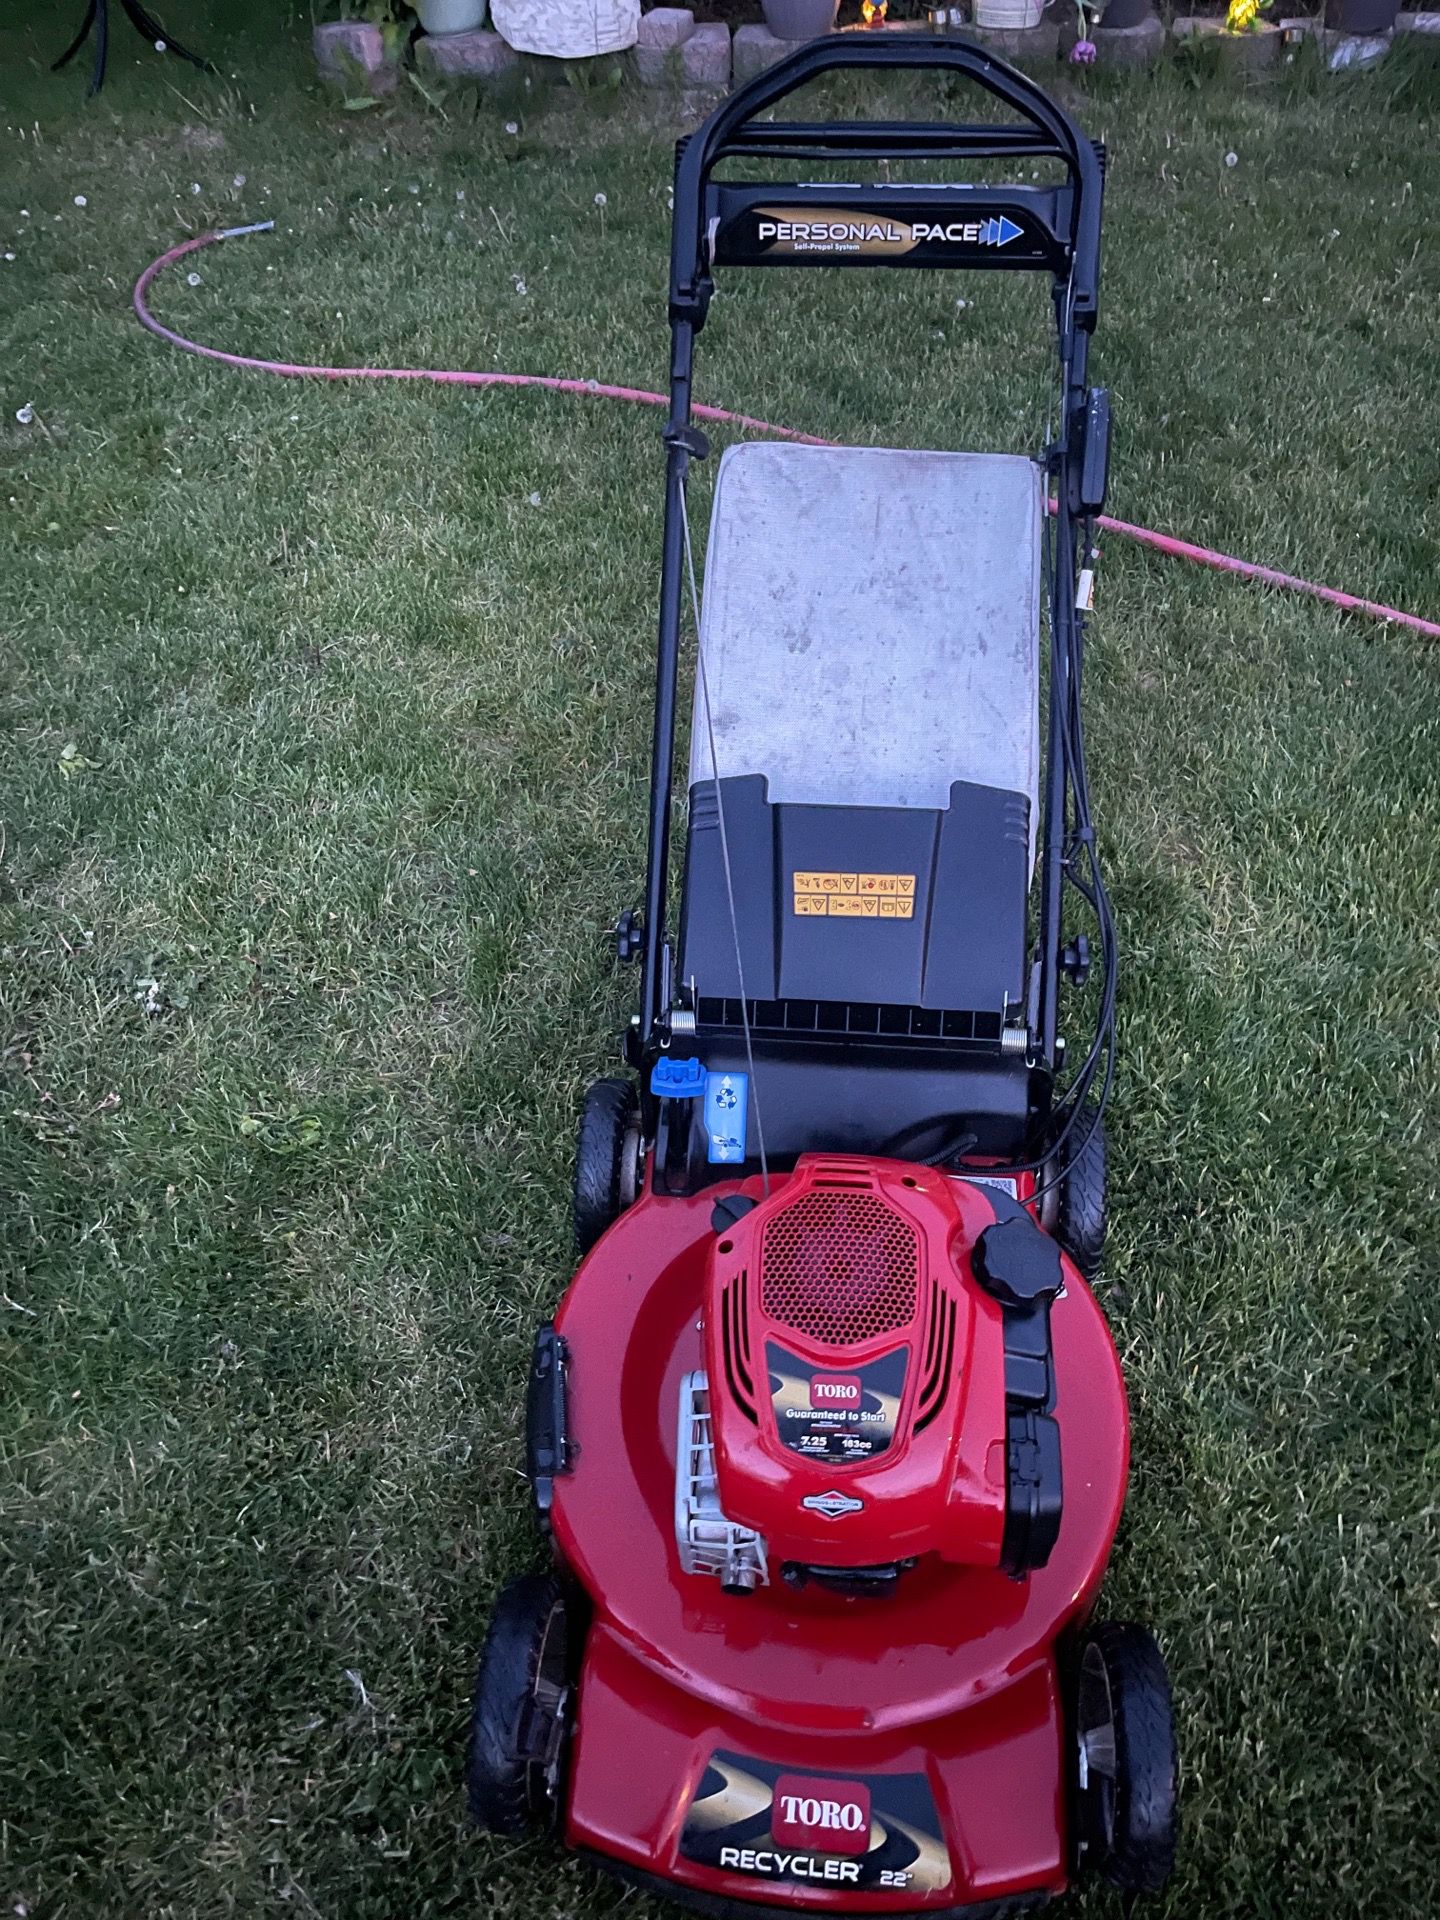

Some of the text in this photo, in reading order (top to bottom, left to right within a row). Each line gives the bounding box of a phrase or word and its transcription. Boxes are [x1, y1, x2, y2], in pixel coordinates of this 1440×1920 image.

[759, 223, 979, 241] PERSONAL PACE
[794, 242, 860, 252] Self-Propel System
[815, 1384, 858, 1398] TORO
[786, 1409, 885, 1422] Guaranteed to Start
[800, 1435, 828, 1447] 7.25
[720, 1846, 863, 1882] RECYCLER
